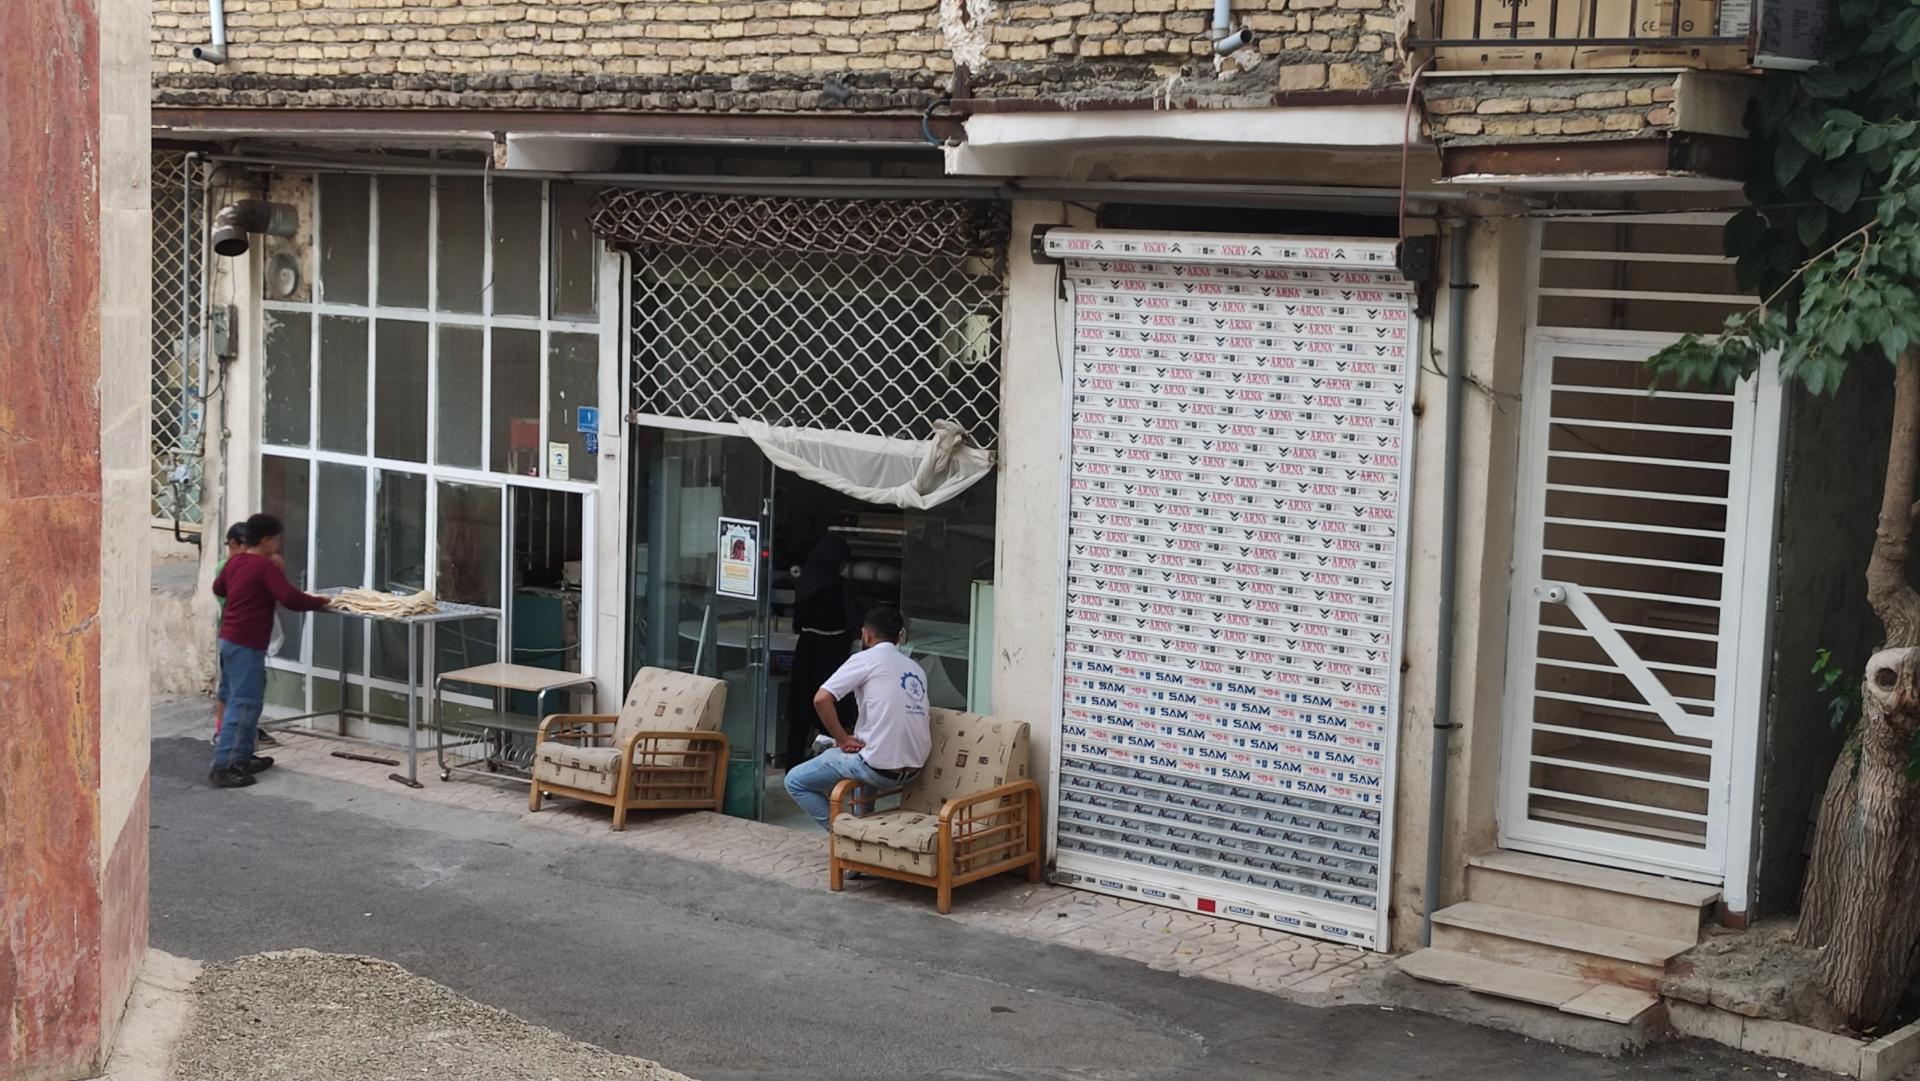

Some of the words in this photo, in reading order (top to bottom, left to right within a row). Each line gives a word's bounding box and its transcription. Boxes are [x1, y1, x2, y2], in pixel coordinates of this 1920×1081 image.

[1112, 262, 1136, 274] ARNA
[1184, 266, 1211, 277] ARNA
[1264, 271, 1288, 281] ARNA
[1344, 273, 1370, 284] ARNA
[1122, 280, 1146, 291] ARNA
[1195, 283, 1222, 295] ARNA
[1275, 287, 1301, 298] ARNA
[1355, 291, 1382, 303] ARNA
[1081, 311, 1102, 321] ARNA
[1152, 316, 1175, 325] ARNA
[1230, 320, 1253, 330] ARNA
[1308, 324, 1333, 334] ARNA
[1146, 298, 1169, 309] ARNA
[1223, 303, 1246, 313] ARNA
[1300, 306, 1324, 316] ARNA
[1382, 311, 1408, 321] ARNA
[1080, 329, 1104, 339] ARNA
[1153, 334, 1176, 344] ARNA
[1230, 338, 1253, 348] ARNA
[1309, 343, 1332, 353] ARNA
[1098, 364, 1120, 374] ARNA
[1168, 369, 1192, 379] ARNA
[1247, 375, 1270, 385] ARNA
[1326, 379, 1351, 389] ARNA
[1118, 348, 1141, 358] ARNA
[1194, 353, 1216, 363] ARNA
[1271, 357, 1296, 369] ARNA
[1352, 363, 1376, 374] ARNA
[1092, 380, 1113, 390] ARNA
[1163, 386, 1185, 396] ARNA
[1238, 391, 1262, 401] ARNA
[1318, 396, 1342, 407] ARNA
[1082, 412, 1105, 424] ARNA
[1156, 419, 1178, 429] ARNA
[1232, 426, 1255, 436] ARNA
[1311, 432, 1334, 443] ARNA
[1119, 399, 1140, 409] ARNA
[1191, 405, 1213, 414] ARNA
[1268, 411, 1291, 421] ARNA
[1349, 416, 1372, 427] ARNA
[1128, 450, 1150, 460] ARNA
[1202, 457, 1224, 468] ARNA
[1279, 465, 1302, 475] ARNA
[1360, 472, 1385, 482] ARNA
[1142, 435, 1164, 445] ARNA
[1216, 443, 1238, 453] ARNA
[1293, 449, 1316, 458] ARNA
[1372, 456, 1398, 466] ARNA
[1088, 464, 1109, 474] ARNA
[1160, 470, 1182, 481] ARNA
[1234, 478, 1257, 489] ARNA
[1312, 485, 1335, 495] ARNA
[1095, 498, 1117, 508] ARNA
[1168, 506, 1190, 516] ARNA
[1243, 514, 1266, 524] ARNA
[1321, 522, 1345, 532] ARNA
[1136, 487, 1158, 497] ARNA
[1211, 494, 1234, 504] ARNA
[1289, 501, 1312, 512] ARNA
[1368, 508, 1393, 518] ARNA
[1105, 532, 1126, 542] ARNA
[1178, 540, 1200, 550] ARNA
[1253, 548, 1276, 560] ARNA
[1332, 557, 1356, 568] ARNA
[1110, 516, 1131, 526] ARNA
[1181, 524, 1205, 534] ARNA
[1258, 532, 1281, 542] ARNA
[1336, 540, 1360, 551] ARNA
[1088, 547, 1109, 557] ARNA
[1162, 555, 1184, 565] ARNA
[1236, 564, 1259, 575] ARNA
[1314, 575, 1339, 585] ARNA
[1103, 566, 1125, 576] ARNA
[1176, 574, 1198, 585] ARNA
[1249, 583, 1272, 593] ARNA
[1328, 593, 1352, 603] ARNA
[1080, 595, 1101, 605] ARNA
[1152, 604, 1174, 615] ARNA
[1227, 614, 1249, 626] ARNA
[1304, 624, 1328, 635] ARNA
[1107, 583, 1130, 593] ARNA
[1178, 591, 1202, 601] ARNA
[1255, 602, 1280, 612] ARNA
[1334, 611, 1358, 621] ARNA
[1079, 611, 1100, 621] ARNA
[1149, 621, 1172, 630] ARNA
[1225, 631, 1248, 641] ARNA
[1302, 641, 1325, 652] ARNA
[1103, 631, 1125, 641] ARNA
[1174, 641, 1198, 652] ARNA
[1248, 653, 1272, 662] ARNA
[1328, 663, 1351, 673] ARNA
[1088, 662, 1114, 673] SAM
[1156, 672, 1184, 685] SAM
[1228, 682, 1256, 695] SAM
[1302, 694, 1333, 706] SAM
[1126, 651, 1148, 662] ARNA
[1200, 662, 1222, 673] ARNA
[1277, 673, 1300, 683] ARNA
[1355, 684, 1381, 695] ARNA
[1092, 697, 1118, 709] SAM
[1161, 707, 1188, 720] SAM
[1233, 720, 1262, 732] SAM
[1308, 730, 1338, 743] SAM
[1099, 682, 1126, 694] SAM
[1169, 692, 1197, 704] SAM
[1242, 703, 1271, 716] SAM
[1317, 715, 1347, 727] SAM
[1062, 726, 1086, 736] SAM
[1128, 736, 1156, 749] SAM
[1200, 748, 1228, 760] SAM
[1274, 760, 1302, 773] SAM
[1349, 773, 1380, 786] SAM
[1107, 715, 1134, 727] SAM
[1178, 727, 1206, 739] SAM
[1250, 738, 1279, 752] SAM
[1325, 752, 1355, 764] SAM
[1081, 744, 1107, 756] SAM
[1150, 756, 1178, 768] SAM
[1222, 768, 1250, 780] SAM
[1297, 781, 1327, 794] SAM
